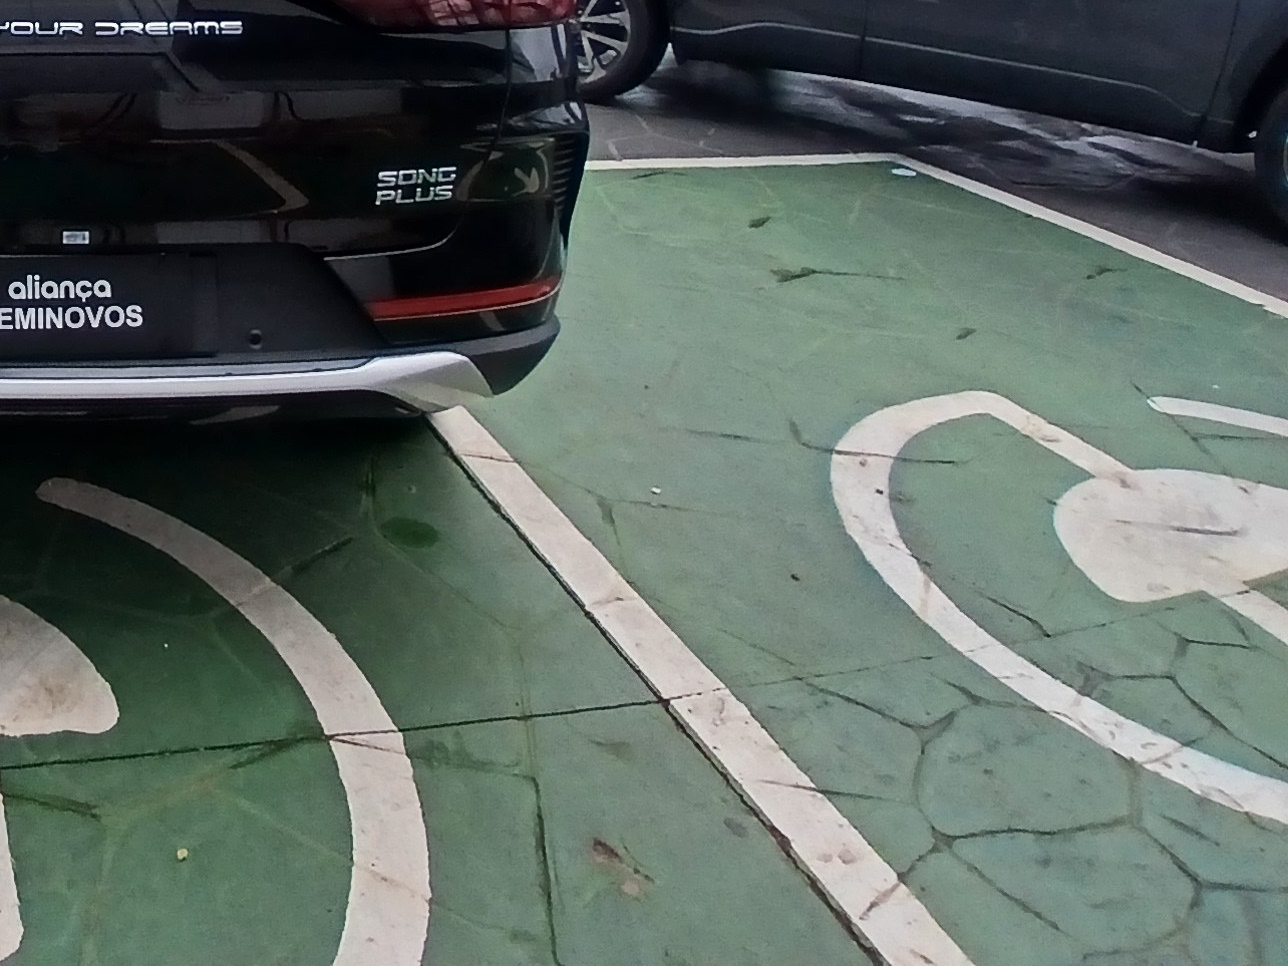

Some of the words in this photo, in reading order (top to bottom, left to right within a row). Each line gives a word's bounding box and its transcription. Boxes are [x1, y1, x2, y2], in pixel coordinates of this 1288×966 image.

[95, 21, 243, 35] DREAMS
[377, 167, 457, 187] SONG
[375, 185, 453, 205] PLUS
[8, 274, 112, 302] aliança
